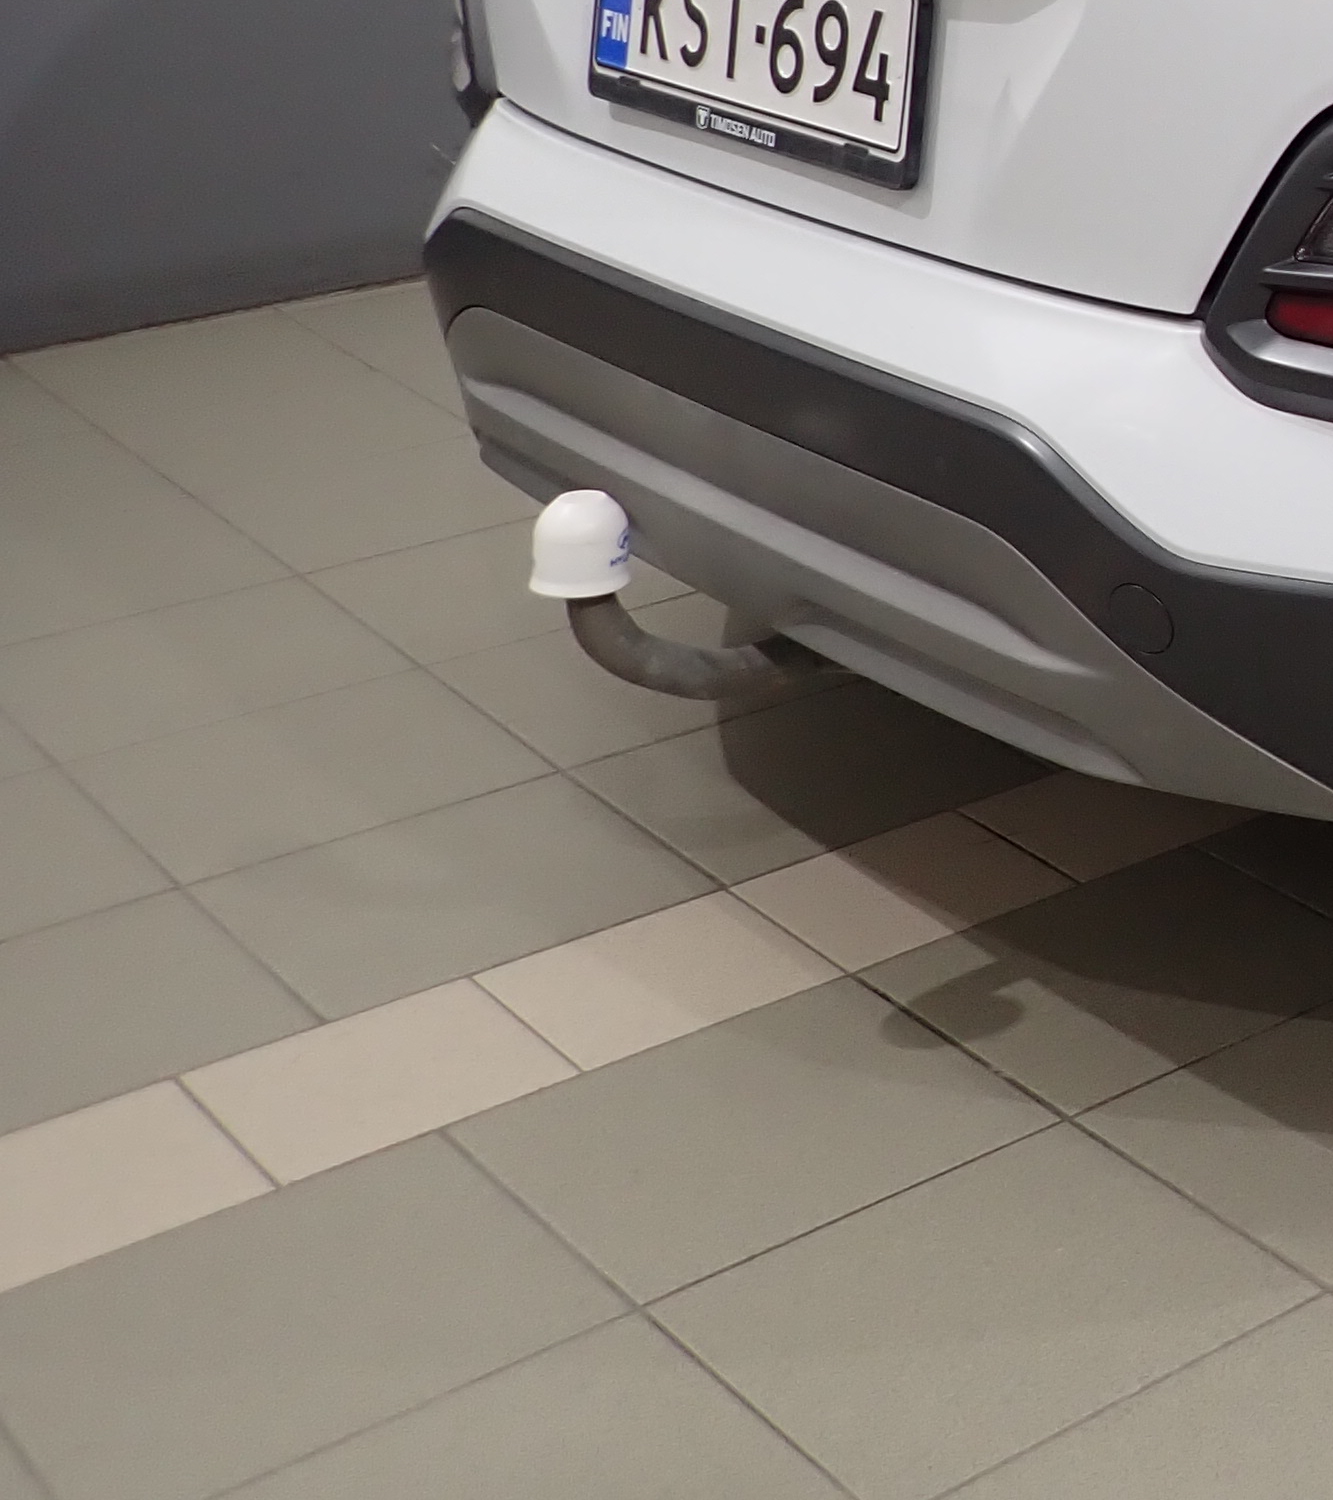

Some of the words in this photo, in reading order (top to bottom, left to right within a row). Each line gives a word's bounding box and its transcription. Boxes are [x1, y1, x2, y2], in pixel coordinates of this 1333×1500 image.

[601, 9, 630, 44] FIN
[710, 113, 751, 140] TIMOSEN
[748, 126, 777, 148] AUTO
